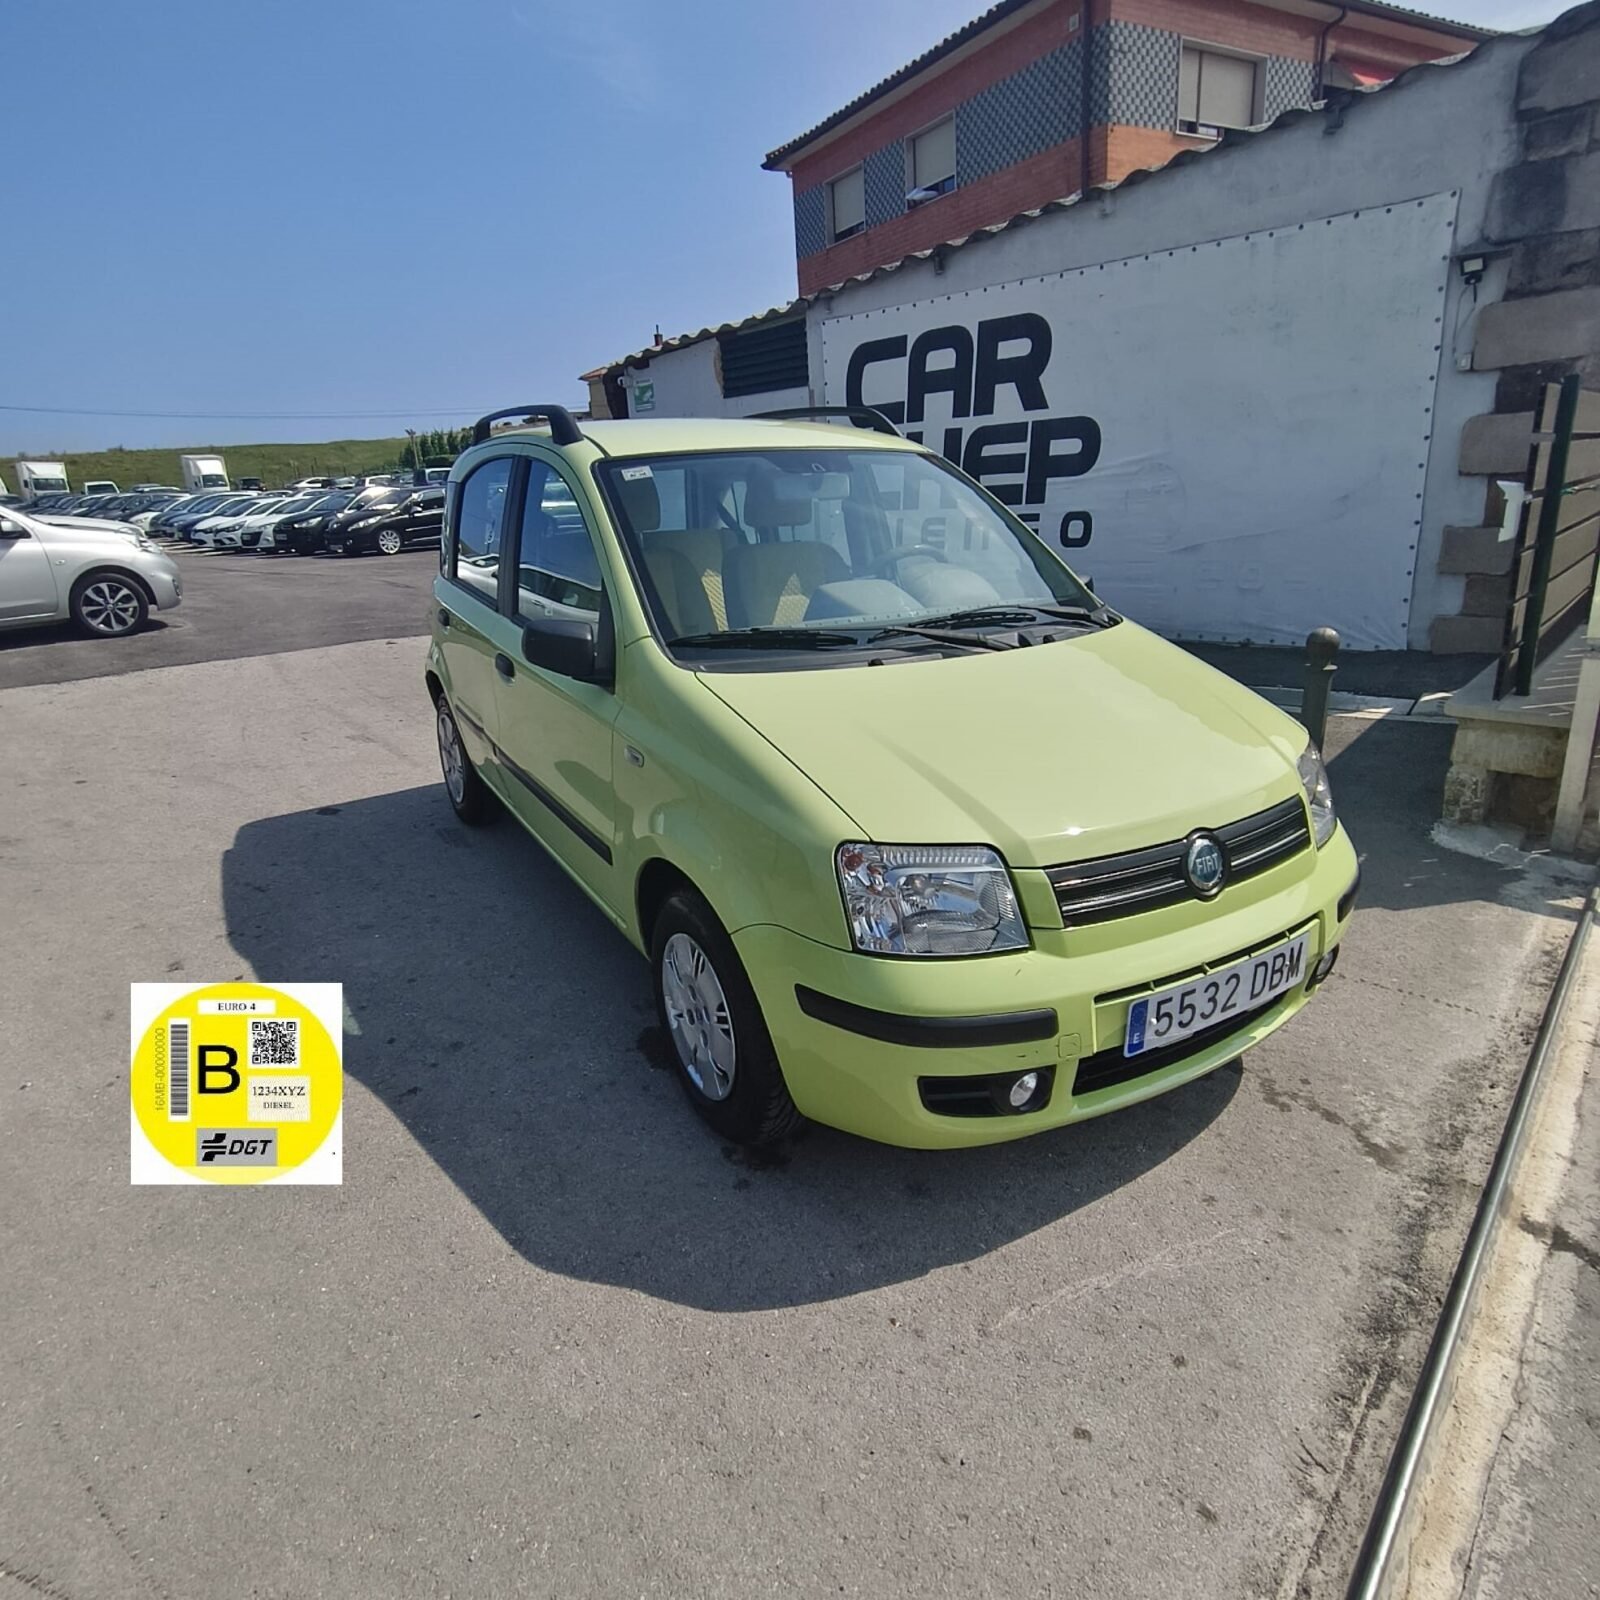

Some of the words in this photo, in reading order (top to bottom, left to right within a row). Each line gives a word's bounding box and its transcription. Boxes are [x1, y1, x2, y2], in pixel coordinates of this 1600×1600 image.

[846, 313, 1052, 427] CAR
[1196, 853, 1218, 875] FIAT
[1155, 974, 1240, 1036] 5532
[1250, 943, 1303, 1000] DBM
[1133, 1033, 1140, 1043] E
